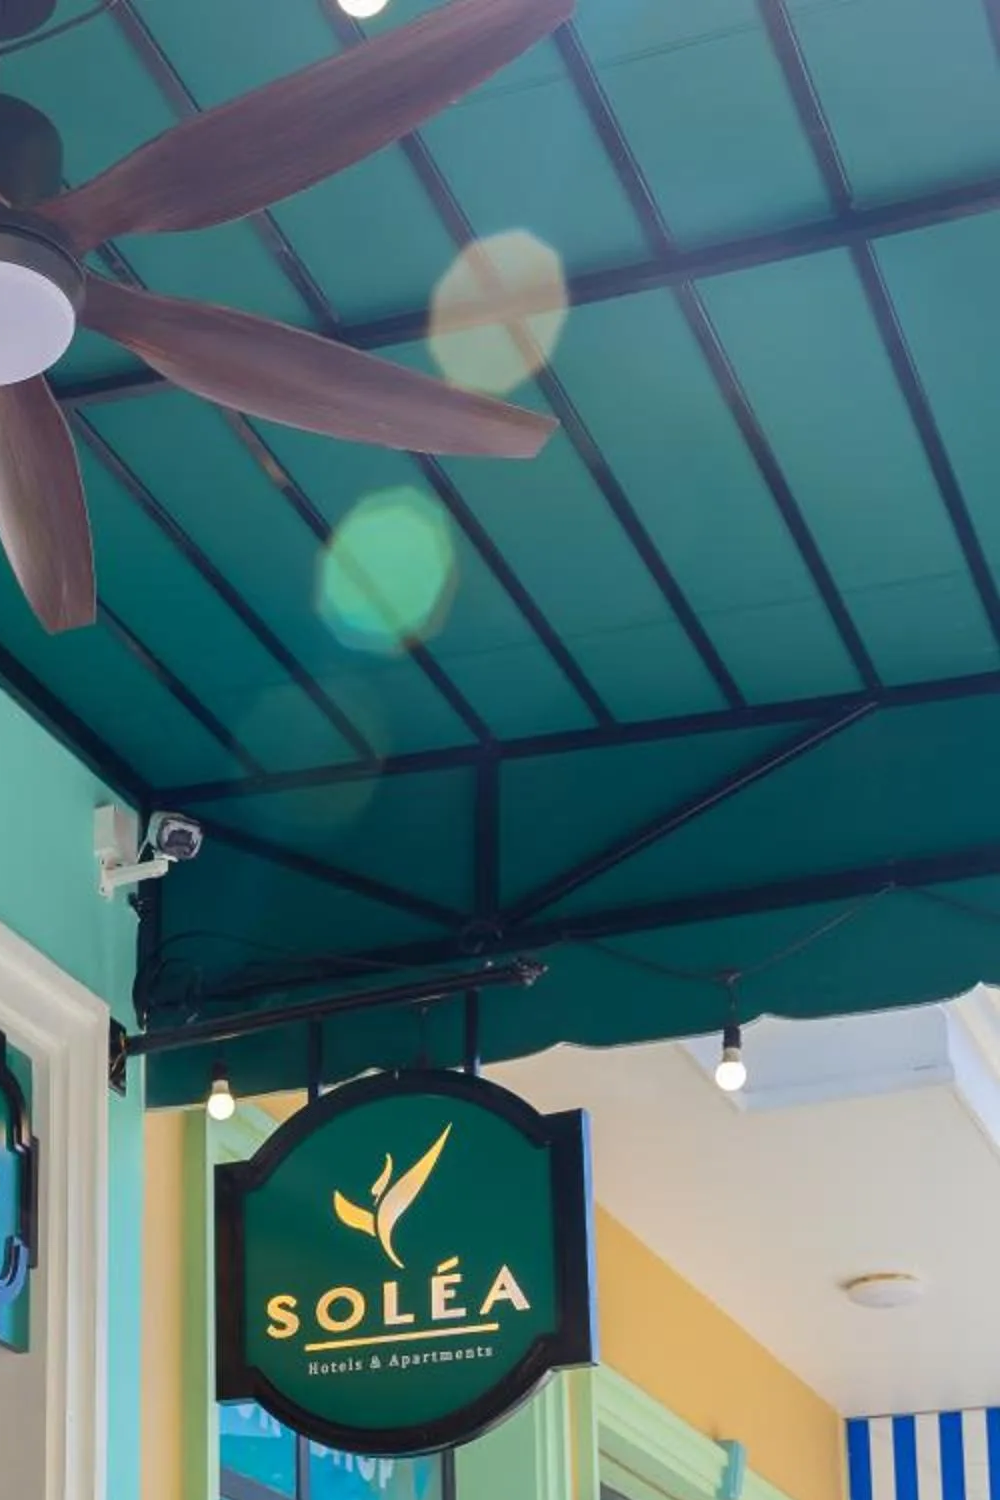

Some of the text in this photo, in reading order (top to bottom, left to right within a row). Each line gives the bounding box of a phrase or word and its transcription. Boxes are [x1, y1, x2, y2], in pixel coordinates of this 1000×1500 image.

[266, 1256, 531, 1339] SOLÉA
[308, 1345, 494, 1375] Hotels & Apartments
